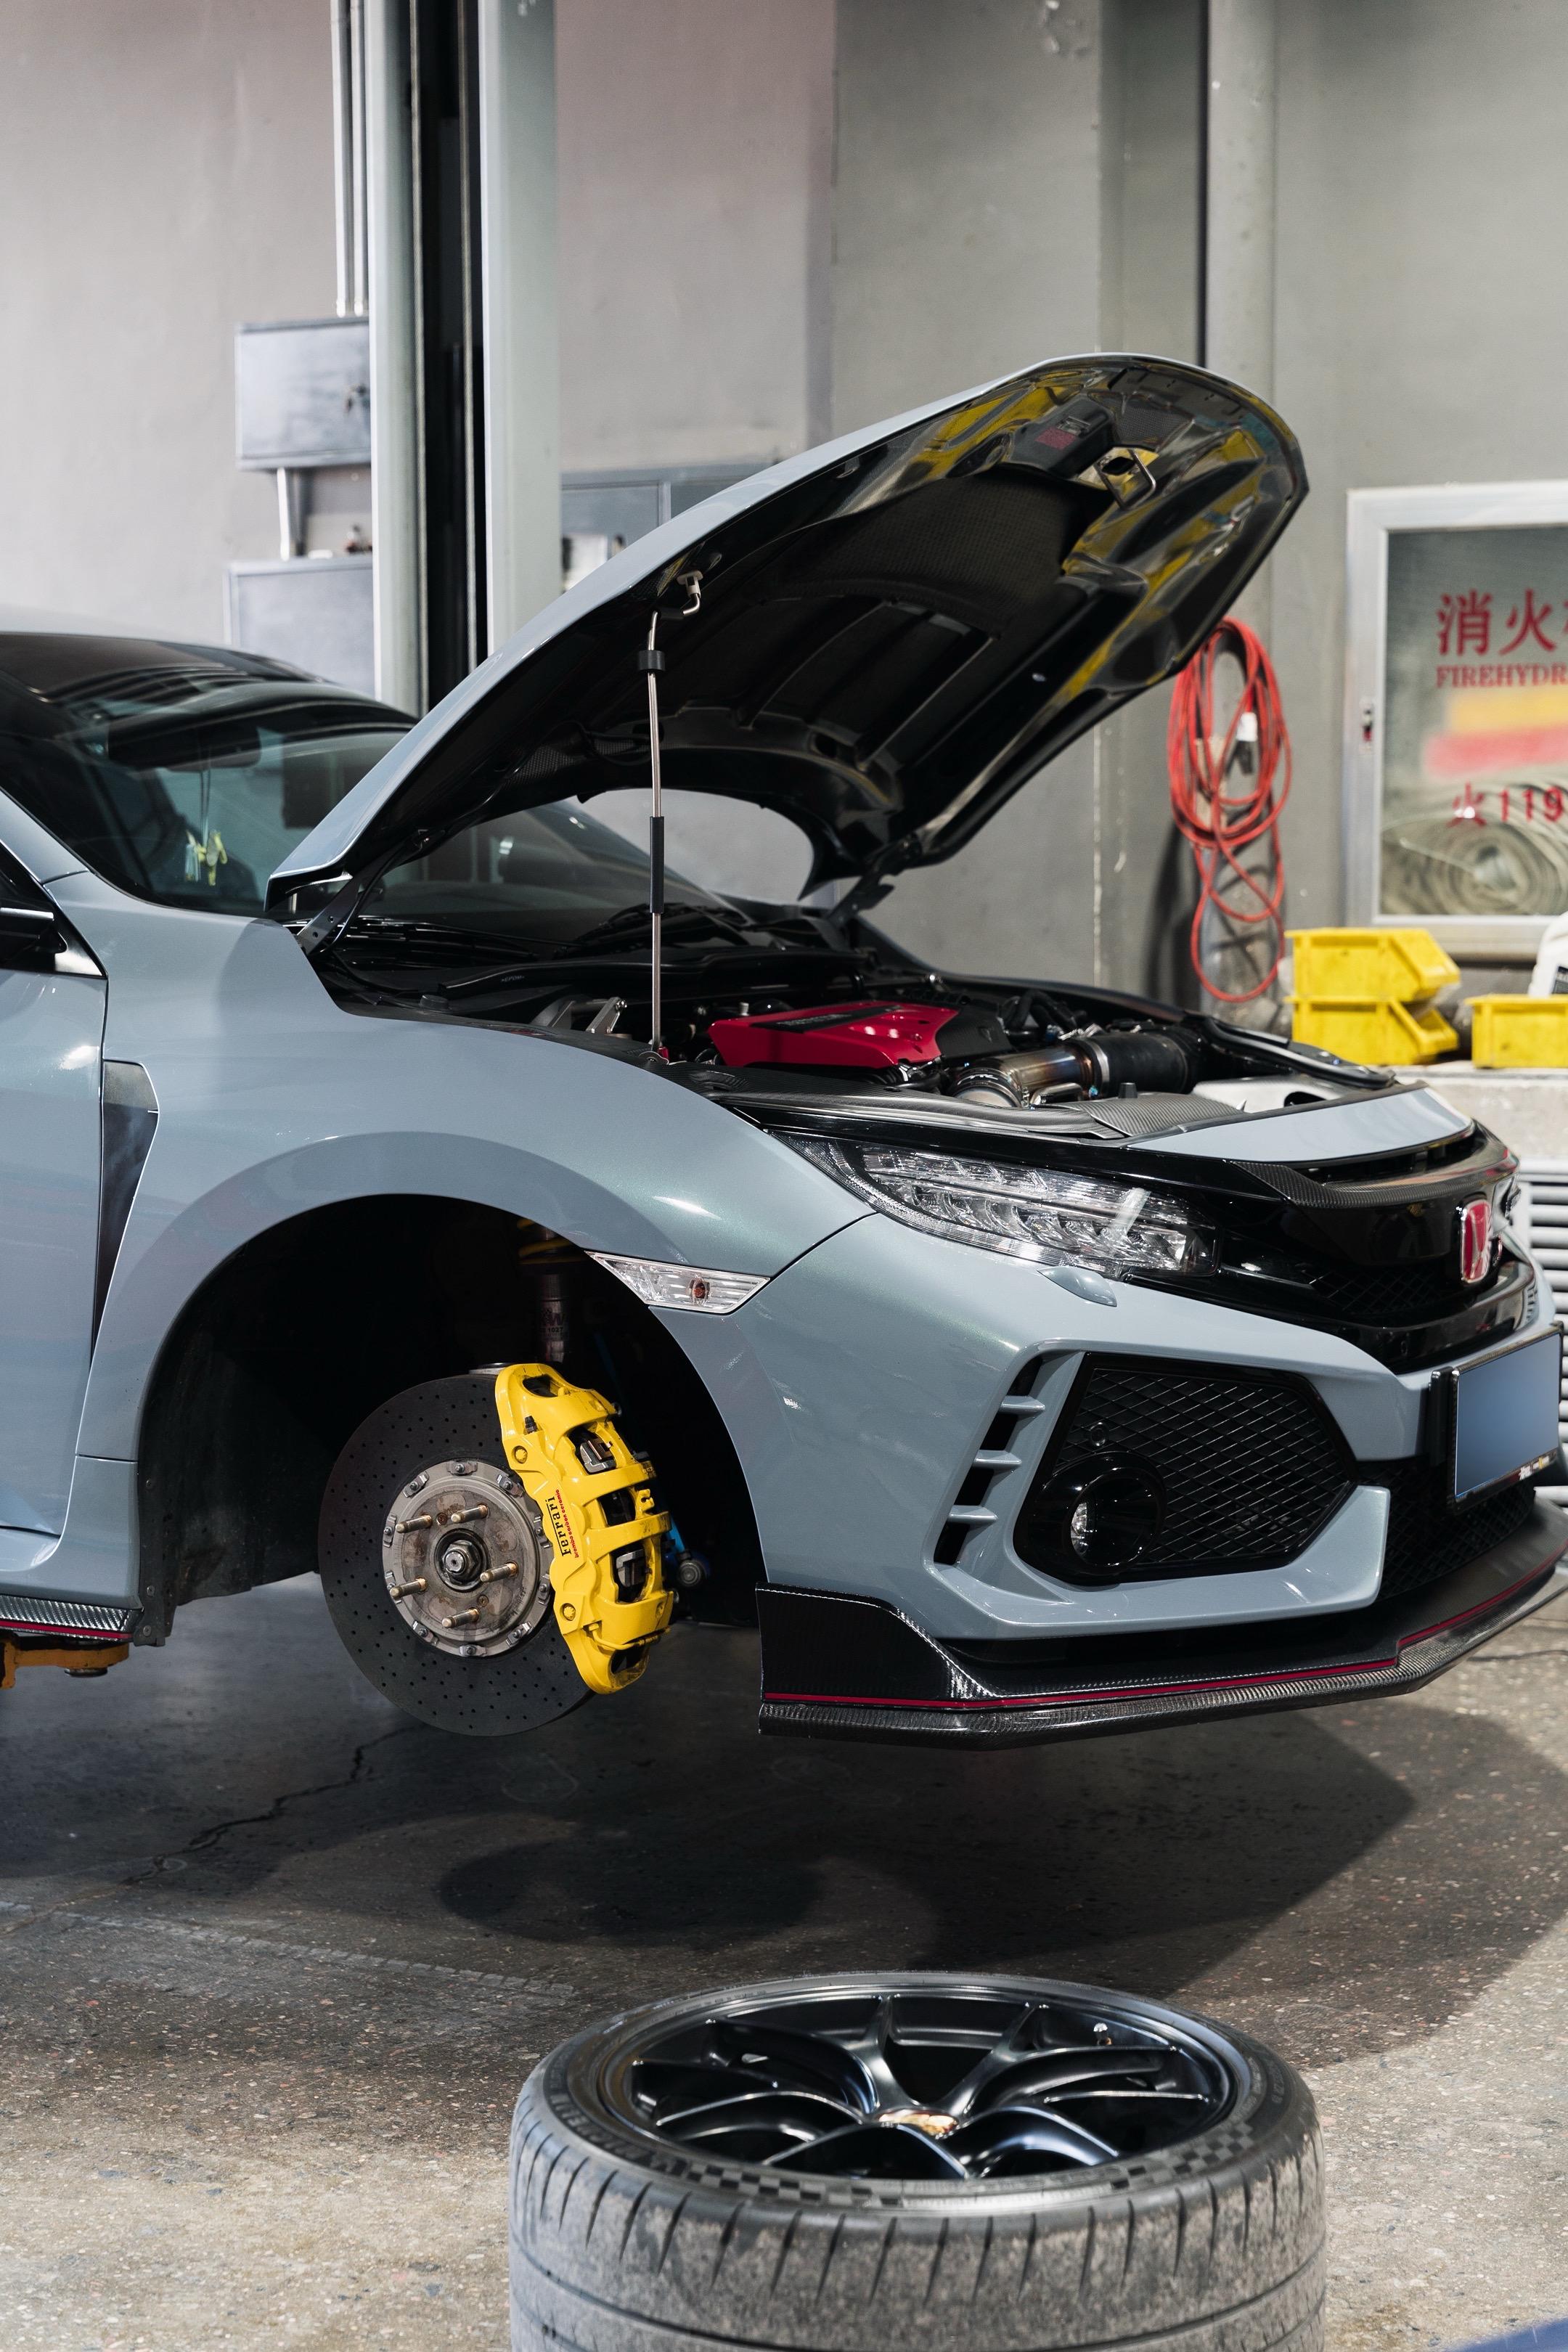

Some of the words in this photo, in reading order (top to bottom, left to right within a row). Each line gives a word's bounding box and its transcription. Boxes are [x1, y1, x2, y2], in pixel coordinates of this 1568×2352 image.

[1437, 589, 1568, 656] 消火
[555, 1489, 565, 1514] ceramic
[545, 1496, 572, 1556] Ferrari
[563, 1514, 572, 1535] carbon
[570, 1536, 579, 1558] brembo
